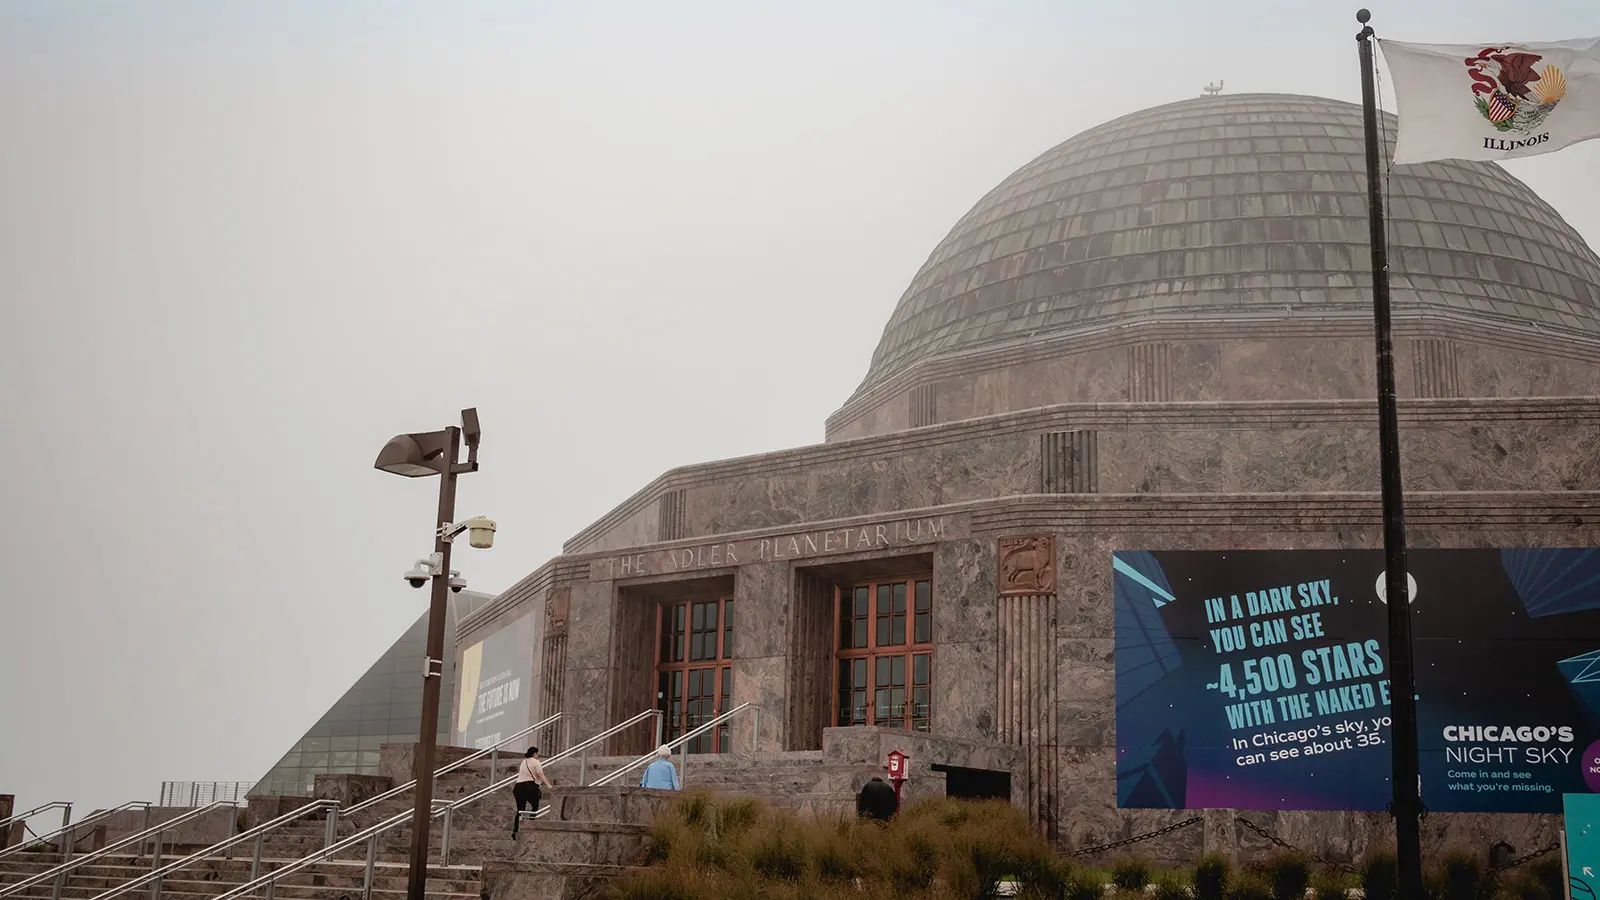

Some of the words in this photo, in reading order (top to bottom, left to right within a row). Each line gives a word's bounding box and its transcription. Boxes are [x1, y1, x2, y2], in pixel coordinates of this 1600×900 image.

[1483, 132, 1550, 151] ILLINOIS
[604, 553, 645, 576] THE
[669, 543, 738, 569] ADLER
[760, 517, 946, 560] PLANETARIUM
[1204, 597, 1227, 624] IN
[1231, 595, 1244, 620] A
[1246, 586, 1296, 617] DARK
[1297, 579, 1339, 608] SKY,
[1210, 625, 1247, 653] YOU
[1249, 618, 1288, 648] CAN
[1291, 612, 1325, 641] SEE
[1206, 653, 1297, 700] ~4,500
[1301, 639, 1385, 685] STARS
[1225, 699, 1276, 730] WITH
[1276, 693, 1313, 722] THE
[1315, 683, 1376, 716] NAKED
[1233, 738, 1249, 751] In
[1335, 718, 1369, 735] sky,
[1371, 715, 1393, 731] yo
[1235, 753, 1266, 767] can
[1269, 747, 1300, 761] see
[1303, 736, 1354, 757] about
[1356, 732, 1387, 747] 35.
[1446, 747, 1519, 764] NIGHT
[1525, 747, 1574, 764] SKY
[1447, 770, 1477, 779] Come
[1479, 769, 1489, 779] in
[1490, 769, 1511, 779] and
[1512, 771, 1532, 779] see
[1448, 783, 1474, 792] what
[1511, 783, 1555, 794] missing.
